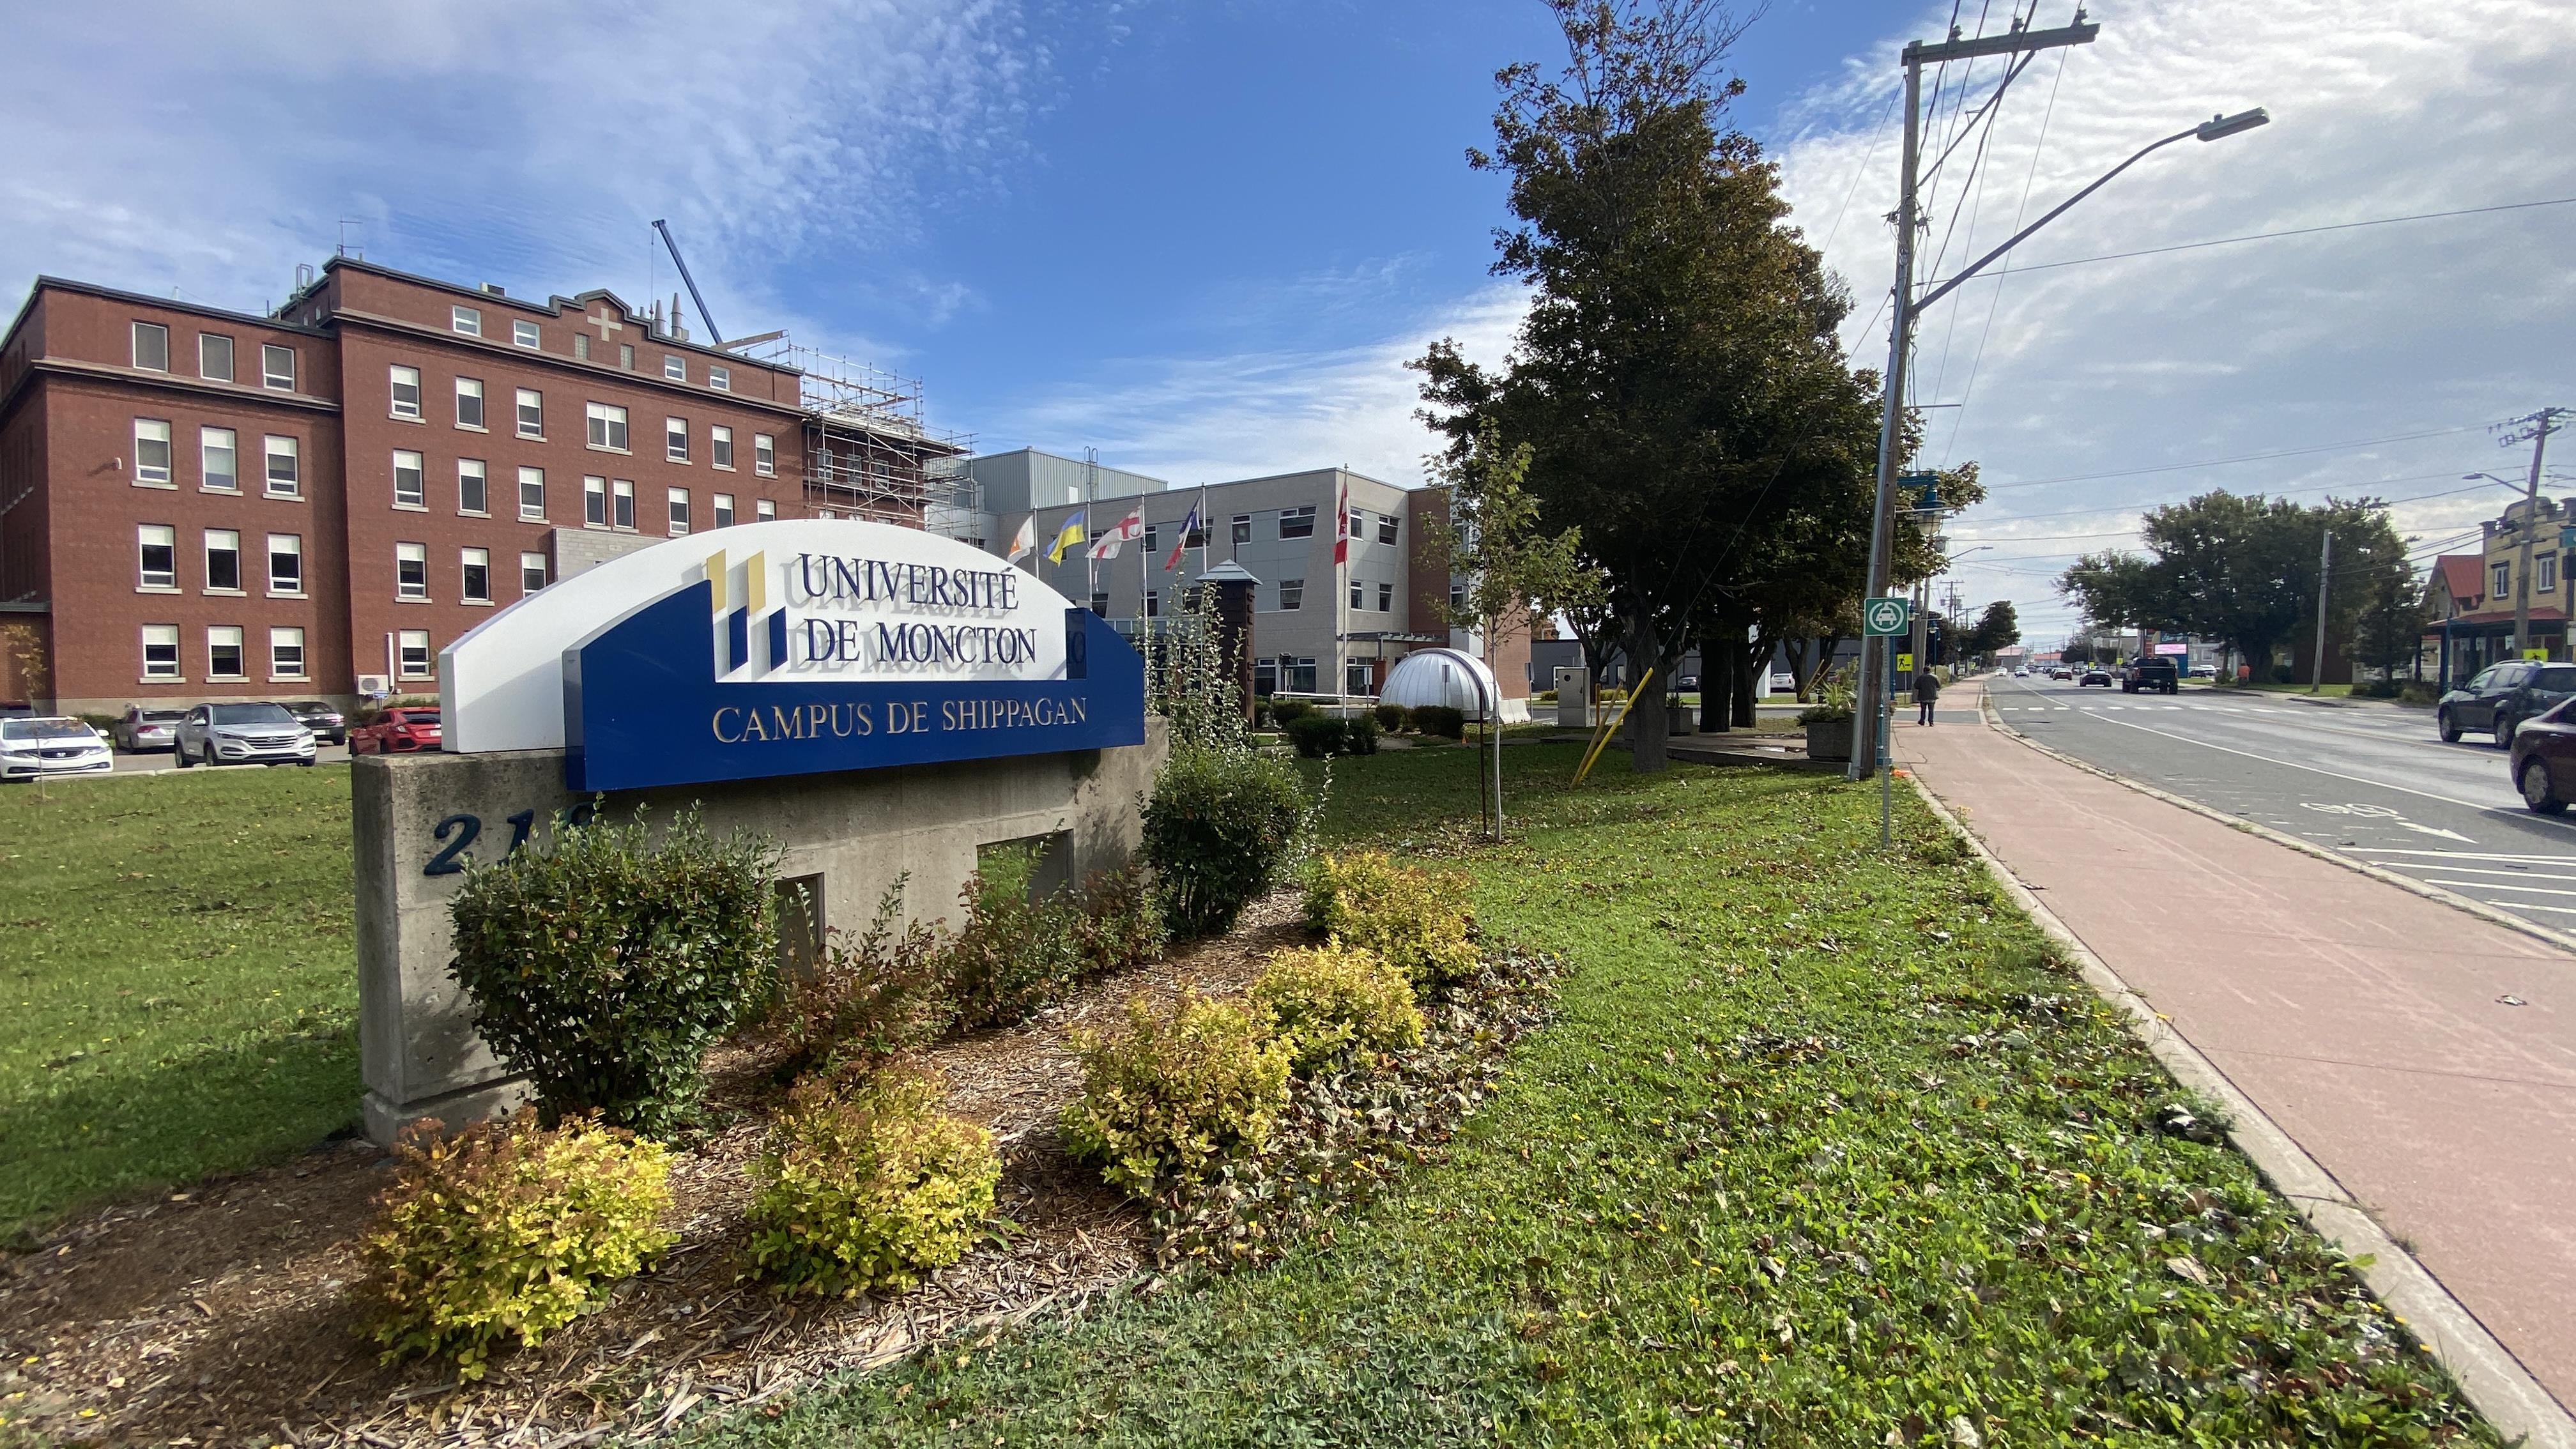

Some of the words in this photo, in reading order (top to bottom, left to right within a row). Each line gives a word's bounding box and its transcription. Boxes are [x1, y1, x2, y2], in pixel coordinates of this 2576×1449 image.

[798, 553, 1020, 610] UNIVERSITÉ
[804, 618, 861, 662] DE
[876, 621, 1037, 664] MONCTON
[712, 703, 875, 744] CAMPUS
[886, 701, 930, 734] DE
[942, 697, 1087, 732] SHIPPAGAN
